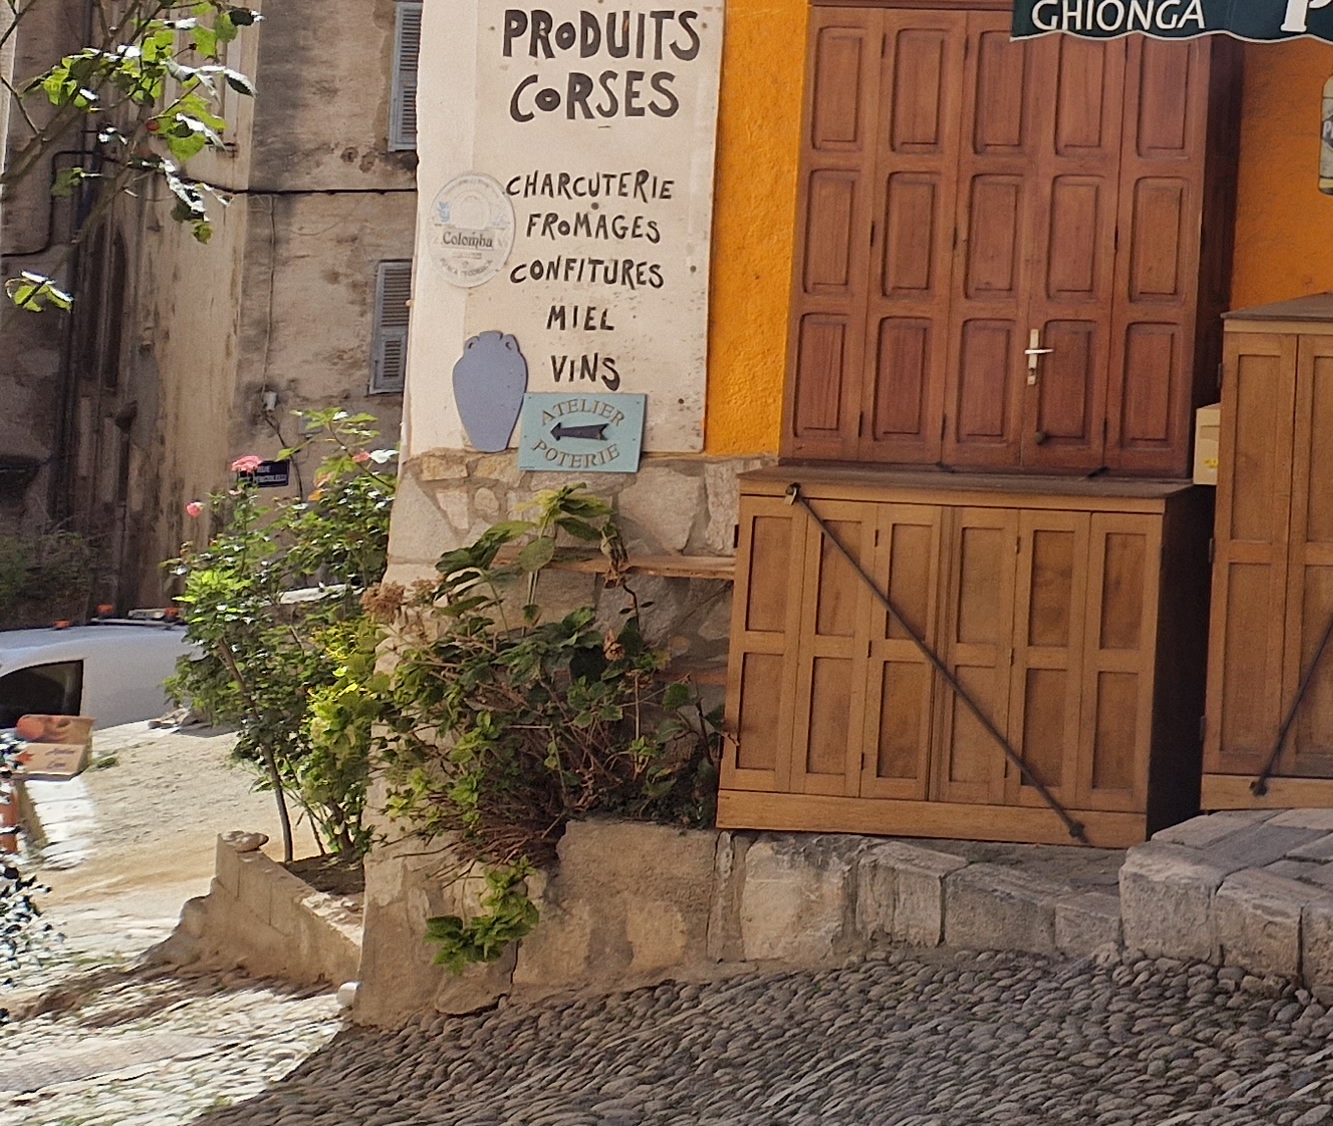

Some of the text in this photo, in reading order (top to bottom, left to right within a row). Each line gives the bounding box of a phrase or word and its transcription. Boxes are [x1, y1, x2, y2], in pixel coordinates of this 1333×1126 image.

[506, 169, 675, 203] CHARCUTERIE
[510, 255, 664, 290] CONFITURES
[546, 304, 615, 331] MIEL
[541, 399, 625, 426] ATELIER
[531, 439, 620, 469] POTERIE
